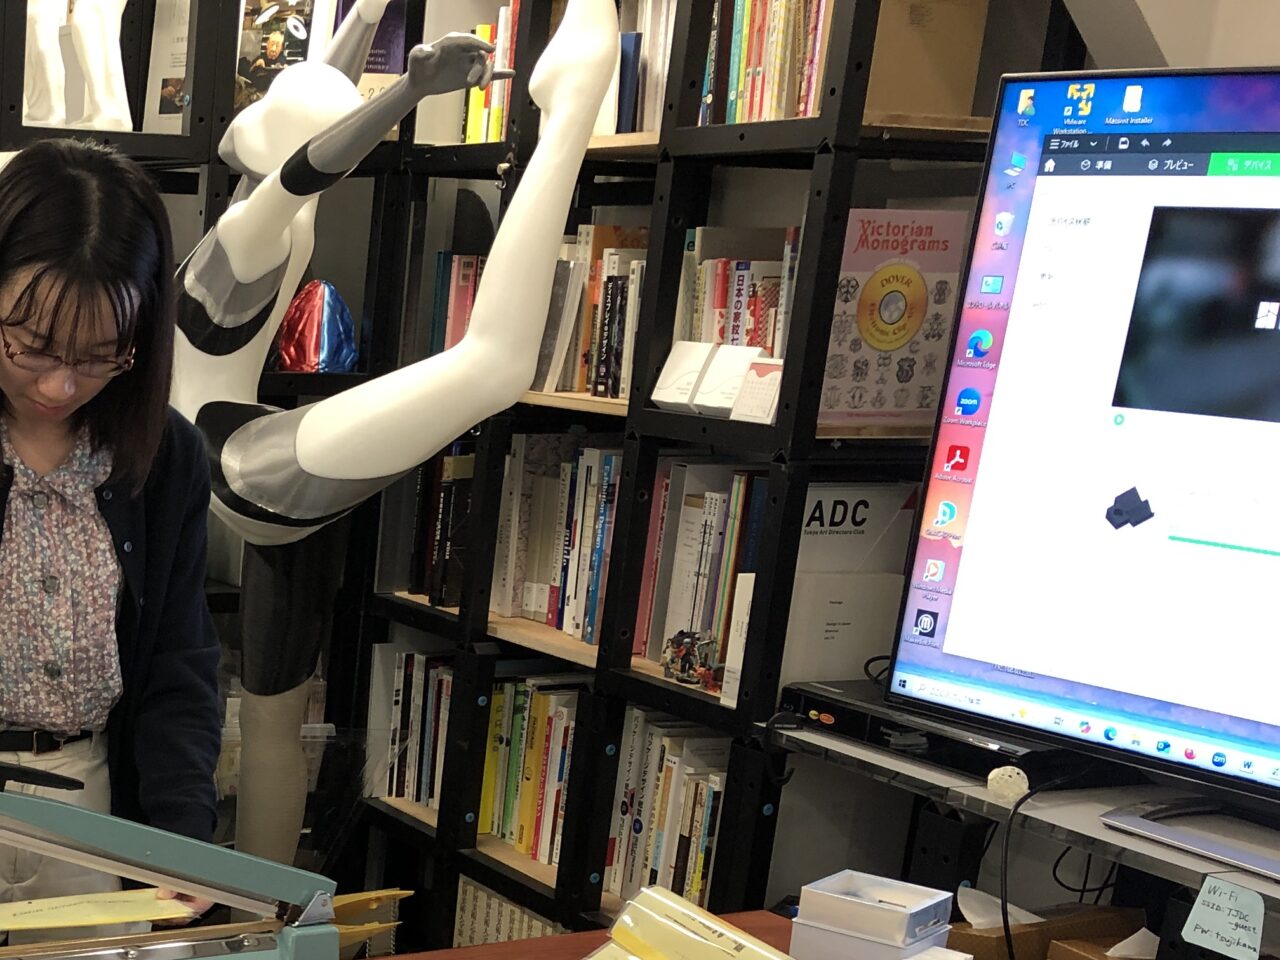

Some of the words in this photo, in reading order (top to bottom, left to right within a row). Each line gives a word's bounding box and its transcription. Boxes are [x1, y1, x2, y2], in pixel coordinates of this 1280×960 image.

[1163, 160, 1194, 170] プレビュー
[1243, 160, 1272, 170] デバイス
[859, 219, 933, 237] Victorian
[853, 234, 949, 255] Monograms
[880, 274, 913, 289] DOVER
[957, 359, 982, 369] Microsoft
[982, 361, 996, 369] Edge
[960, 398, 978, 406] zoom
[805, 499, 869, 527] ADC
[1207, 885, 1238, 902] Wi-Fi
